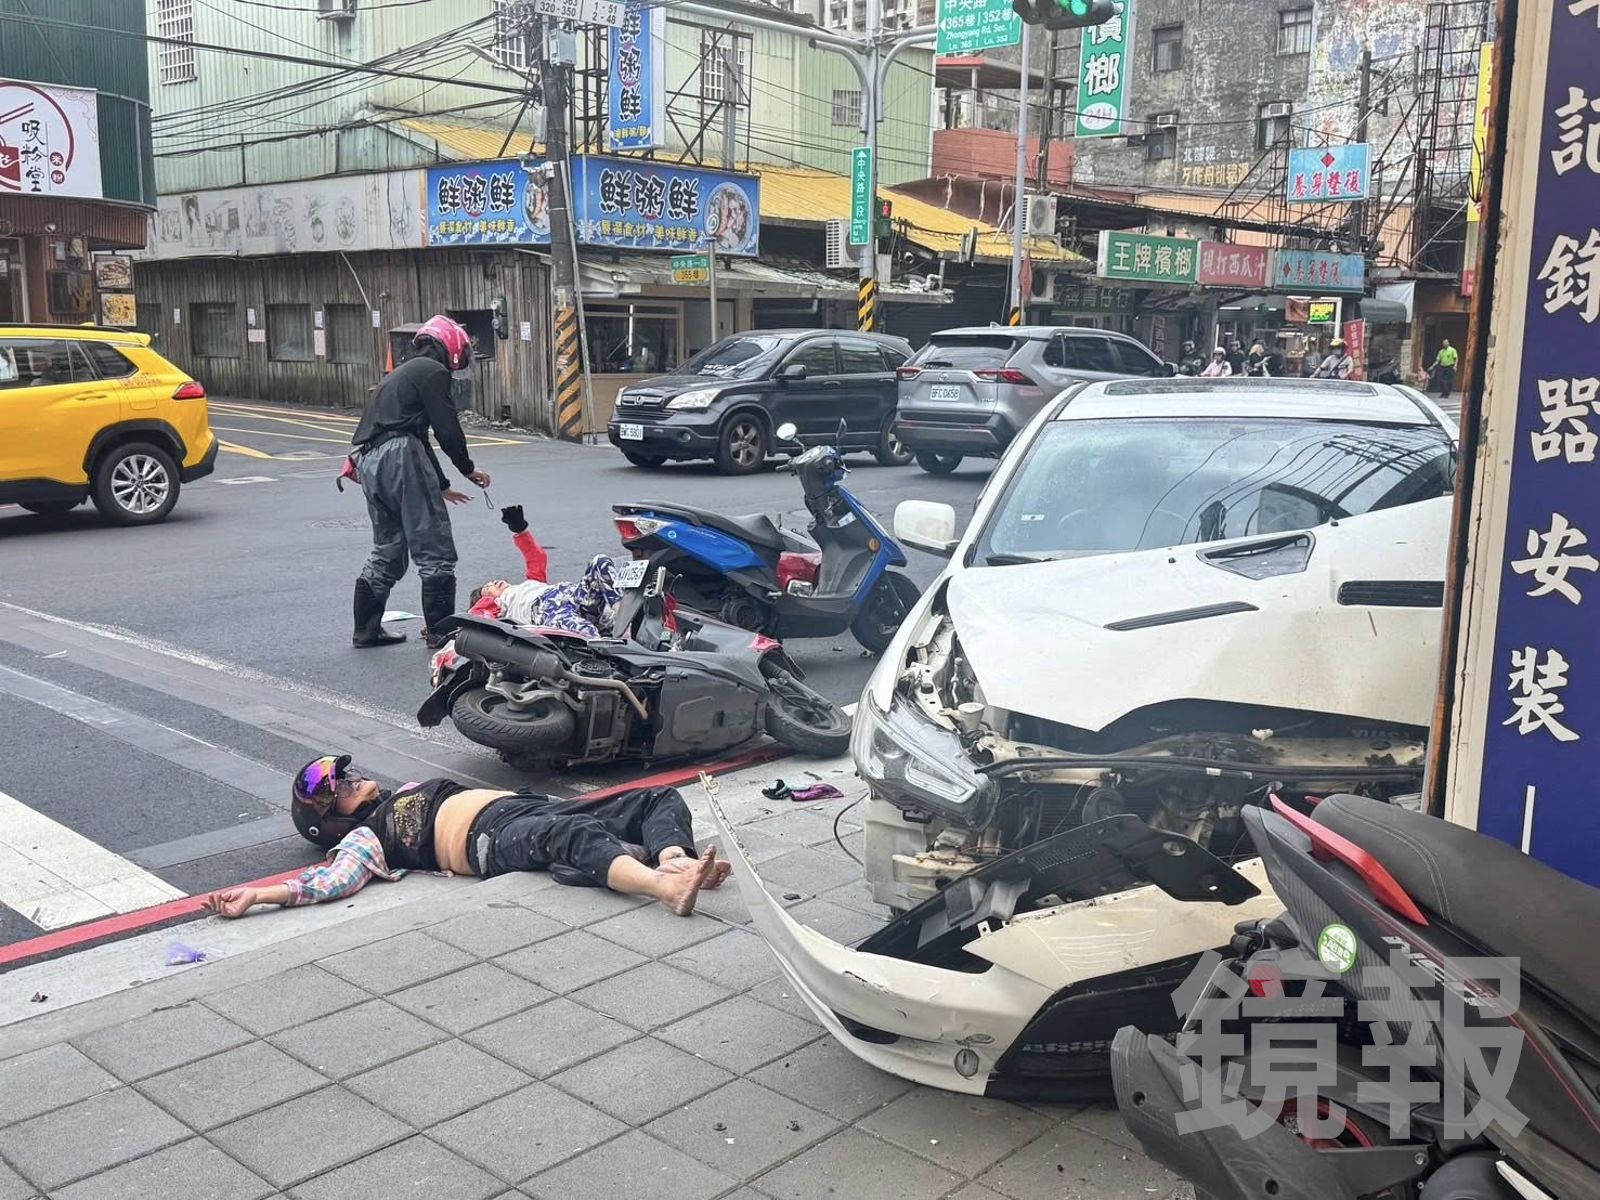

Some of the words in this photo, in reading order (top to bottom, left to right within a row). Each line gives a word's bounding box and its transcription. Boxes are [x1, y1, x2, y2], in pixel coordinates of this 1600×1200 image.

[946, 14, 976, 30] 365巷
[982, 8, 1013, 24] 352巷
[946, 29, 980, 40] Zhongyang
[981, 25, 992, 35] Rd.
[20, 120, 48, 192] 吸粉堂
[438, 173, 515, 214] 鮮粥鮮
[600, 169, 700, 221] 鮮粥鮮
[856, 158, 867, 217] 中央路二段
[1112, 241, 1192, 277] 王牌檳榔
[1203, 251, 1265, 280] 現打西瓜汁
